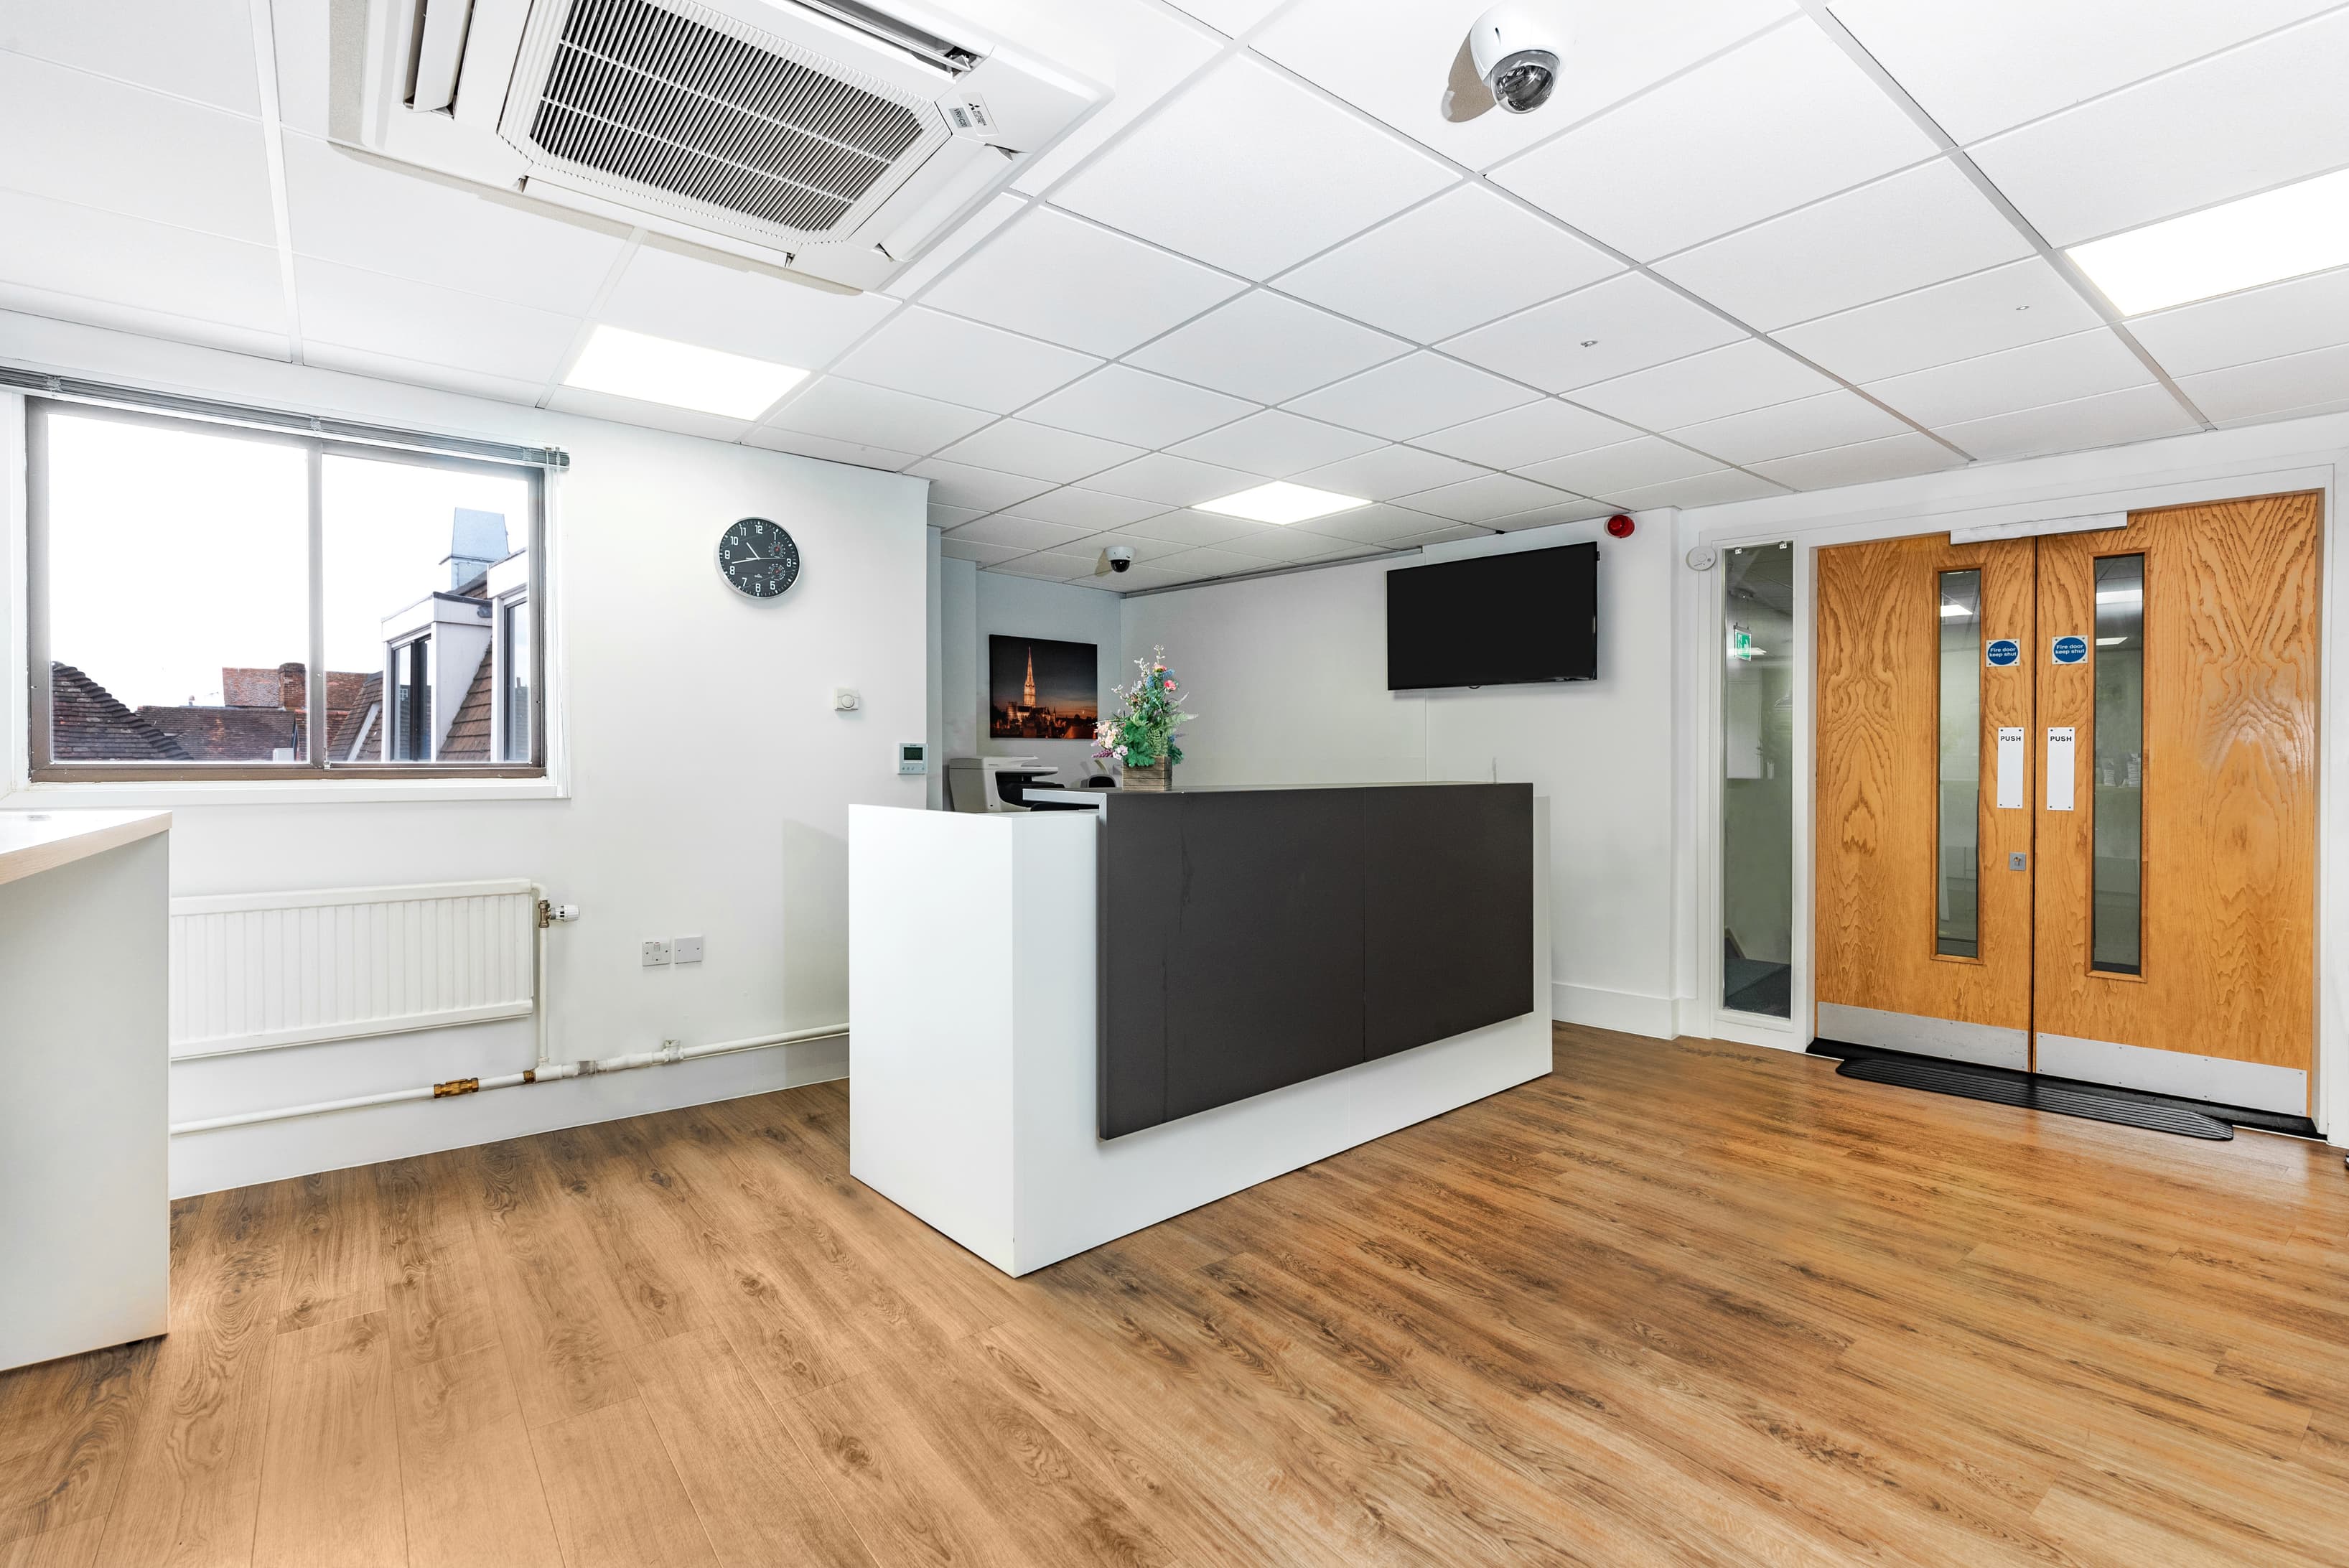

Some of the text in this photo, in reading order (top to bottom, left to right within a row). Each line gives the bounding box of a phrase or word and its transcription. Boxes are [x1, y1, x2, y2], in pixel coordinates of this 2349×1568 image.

[740, 527, 747, 536] 11
[755, 525, 763, 534] 12
[730, 536, 739, 546] 10
[724, 550, 730, 559] 9
[787, 558, 791, 567] 3
[729, 566, 735, 575] 8
[742, 577, 747, 587] 7
